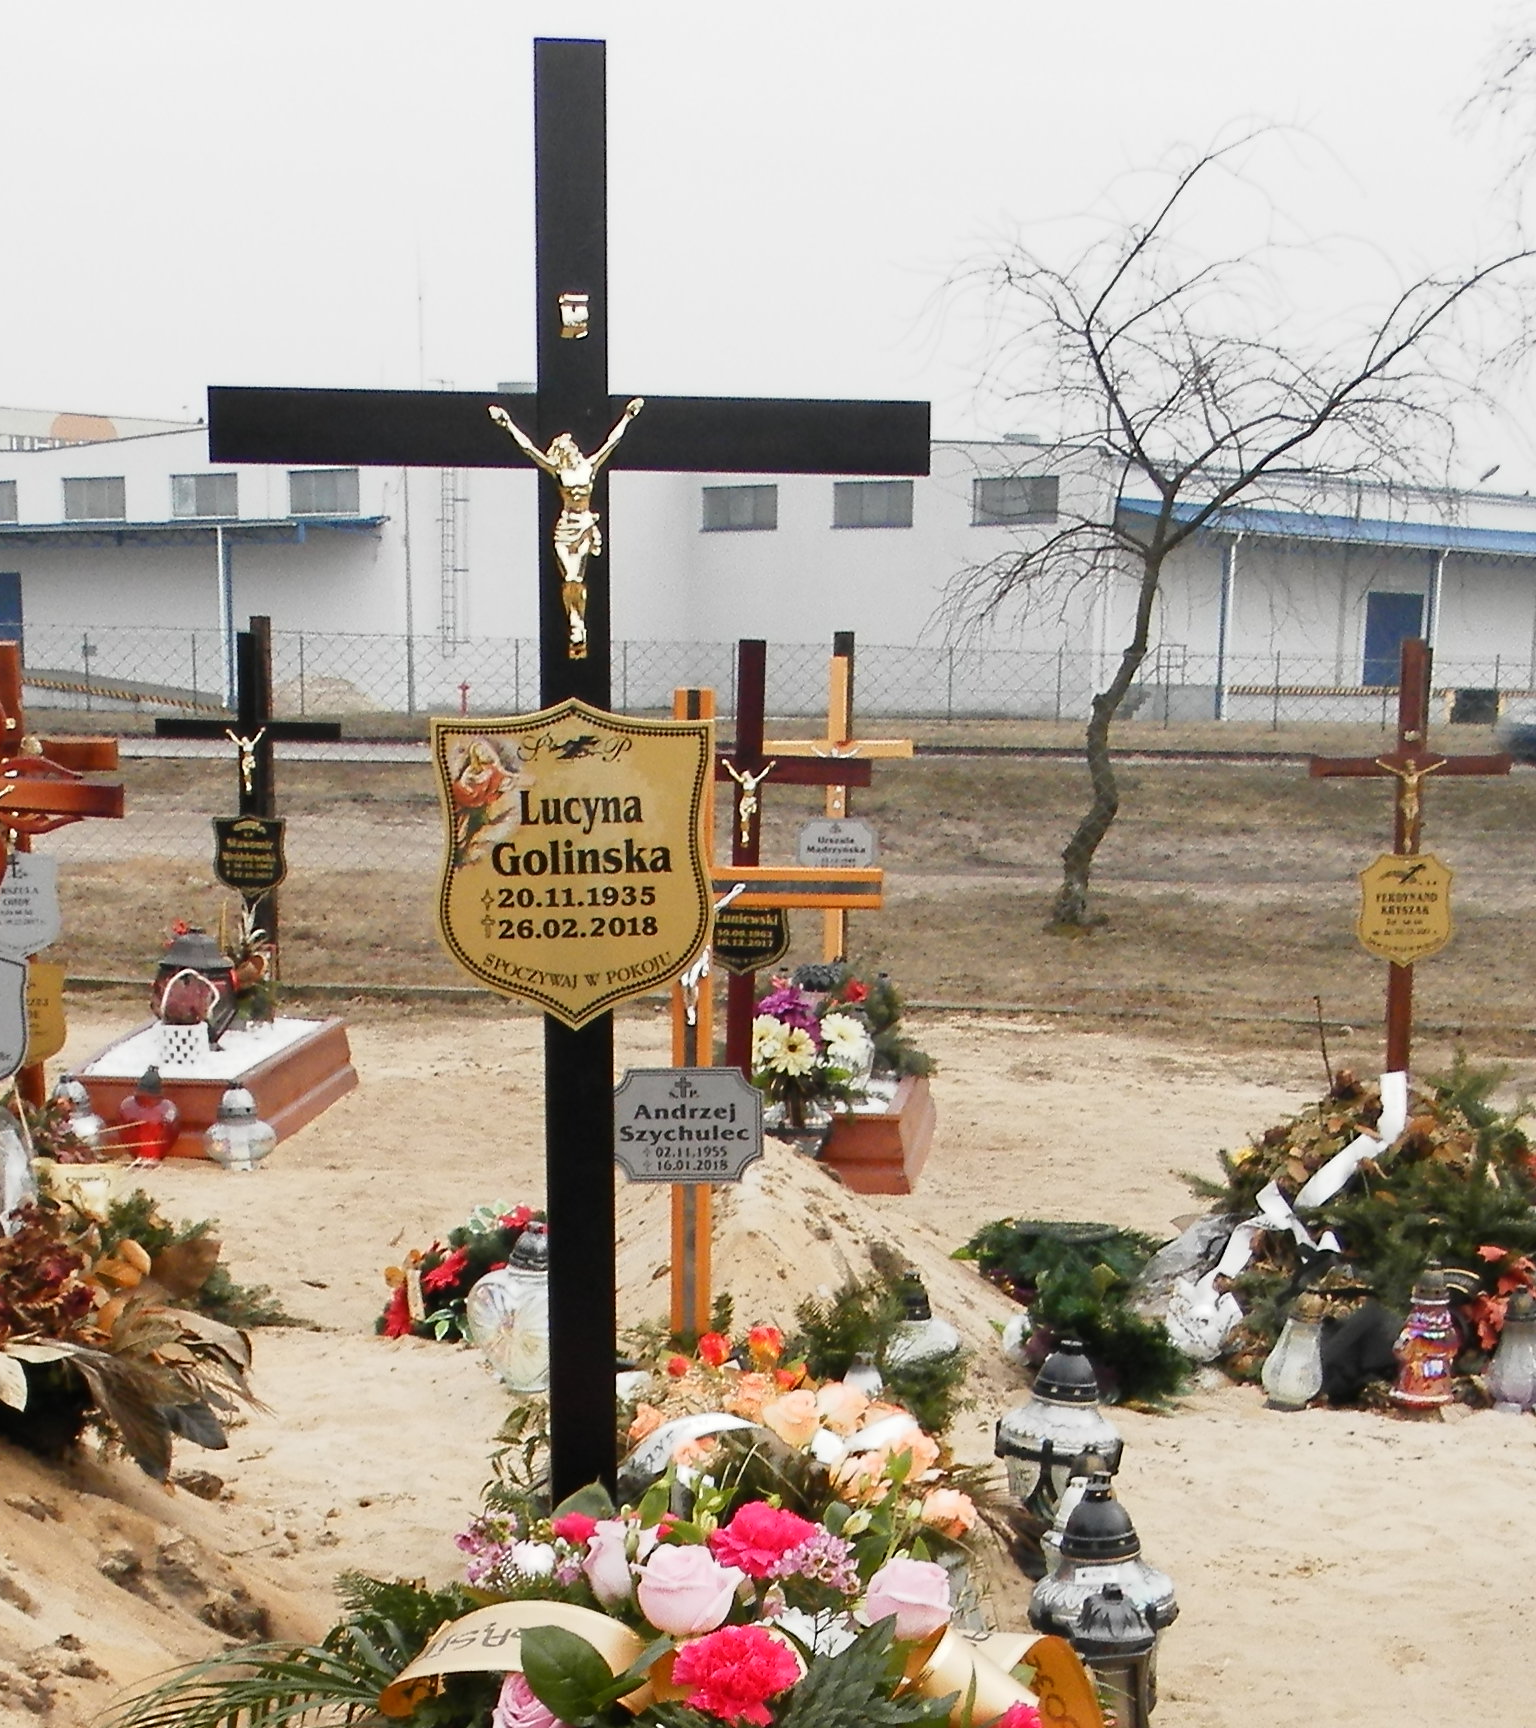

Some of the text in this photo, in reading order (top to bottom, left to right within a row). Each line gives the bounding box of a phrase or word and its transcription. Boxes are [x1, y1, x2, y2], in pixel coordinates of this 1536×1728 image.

[519, 790, 644, 834] Lucyna
[498, 886, 656, 908] 20.11.1935
[1376, 893, 1438, 903] FERDYNAND
[498, 916, 659, 939] 26.02.2018
[482, 951, 672, 990] SPOCZYWAJ W POKOJU
[634, 1103, 736, 1122] Andrzej
[620, 1125, 750, 1146] Szychulec
[656, 1146, 727, 1158] 02.11.1955
[657, 1160, 728, 1171] 16.01.2018
